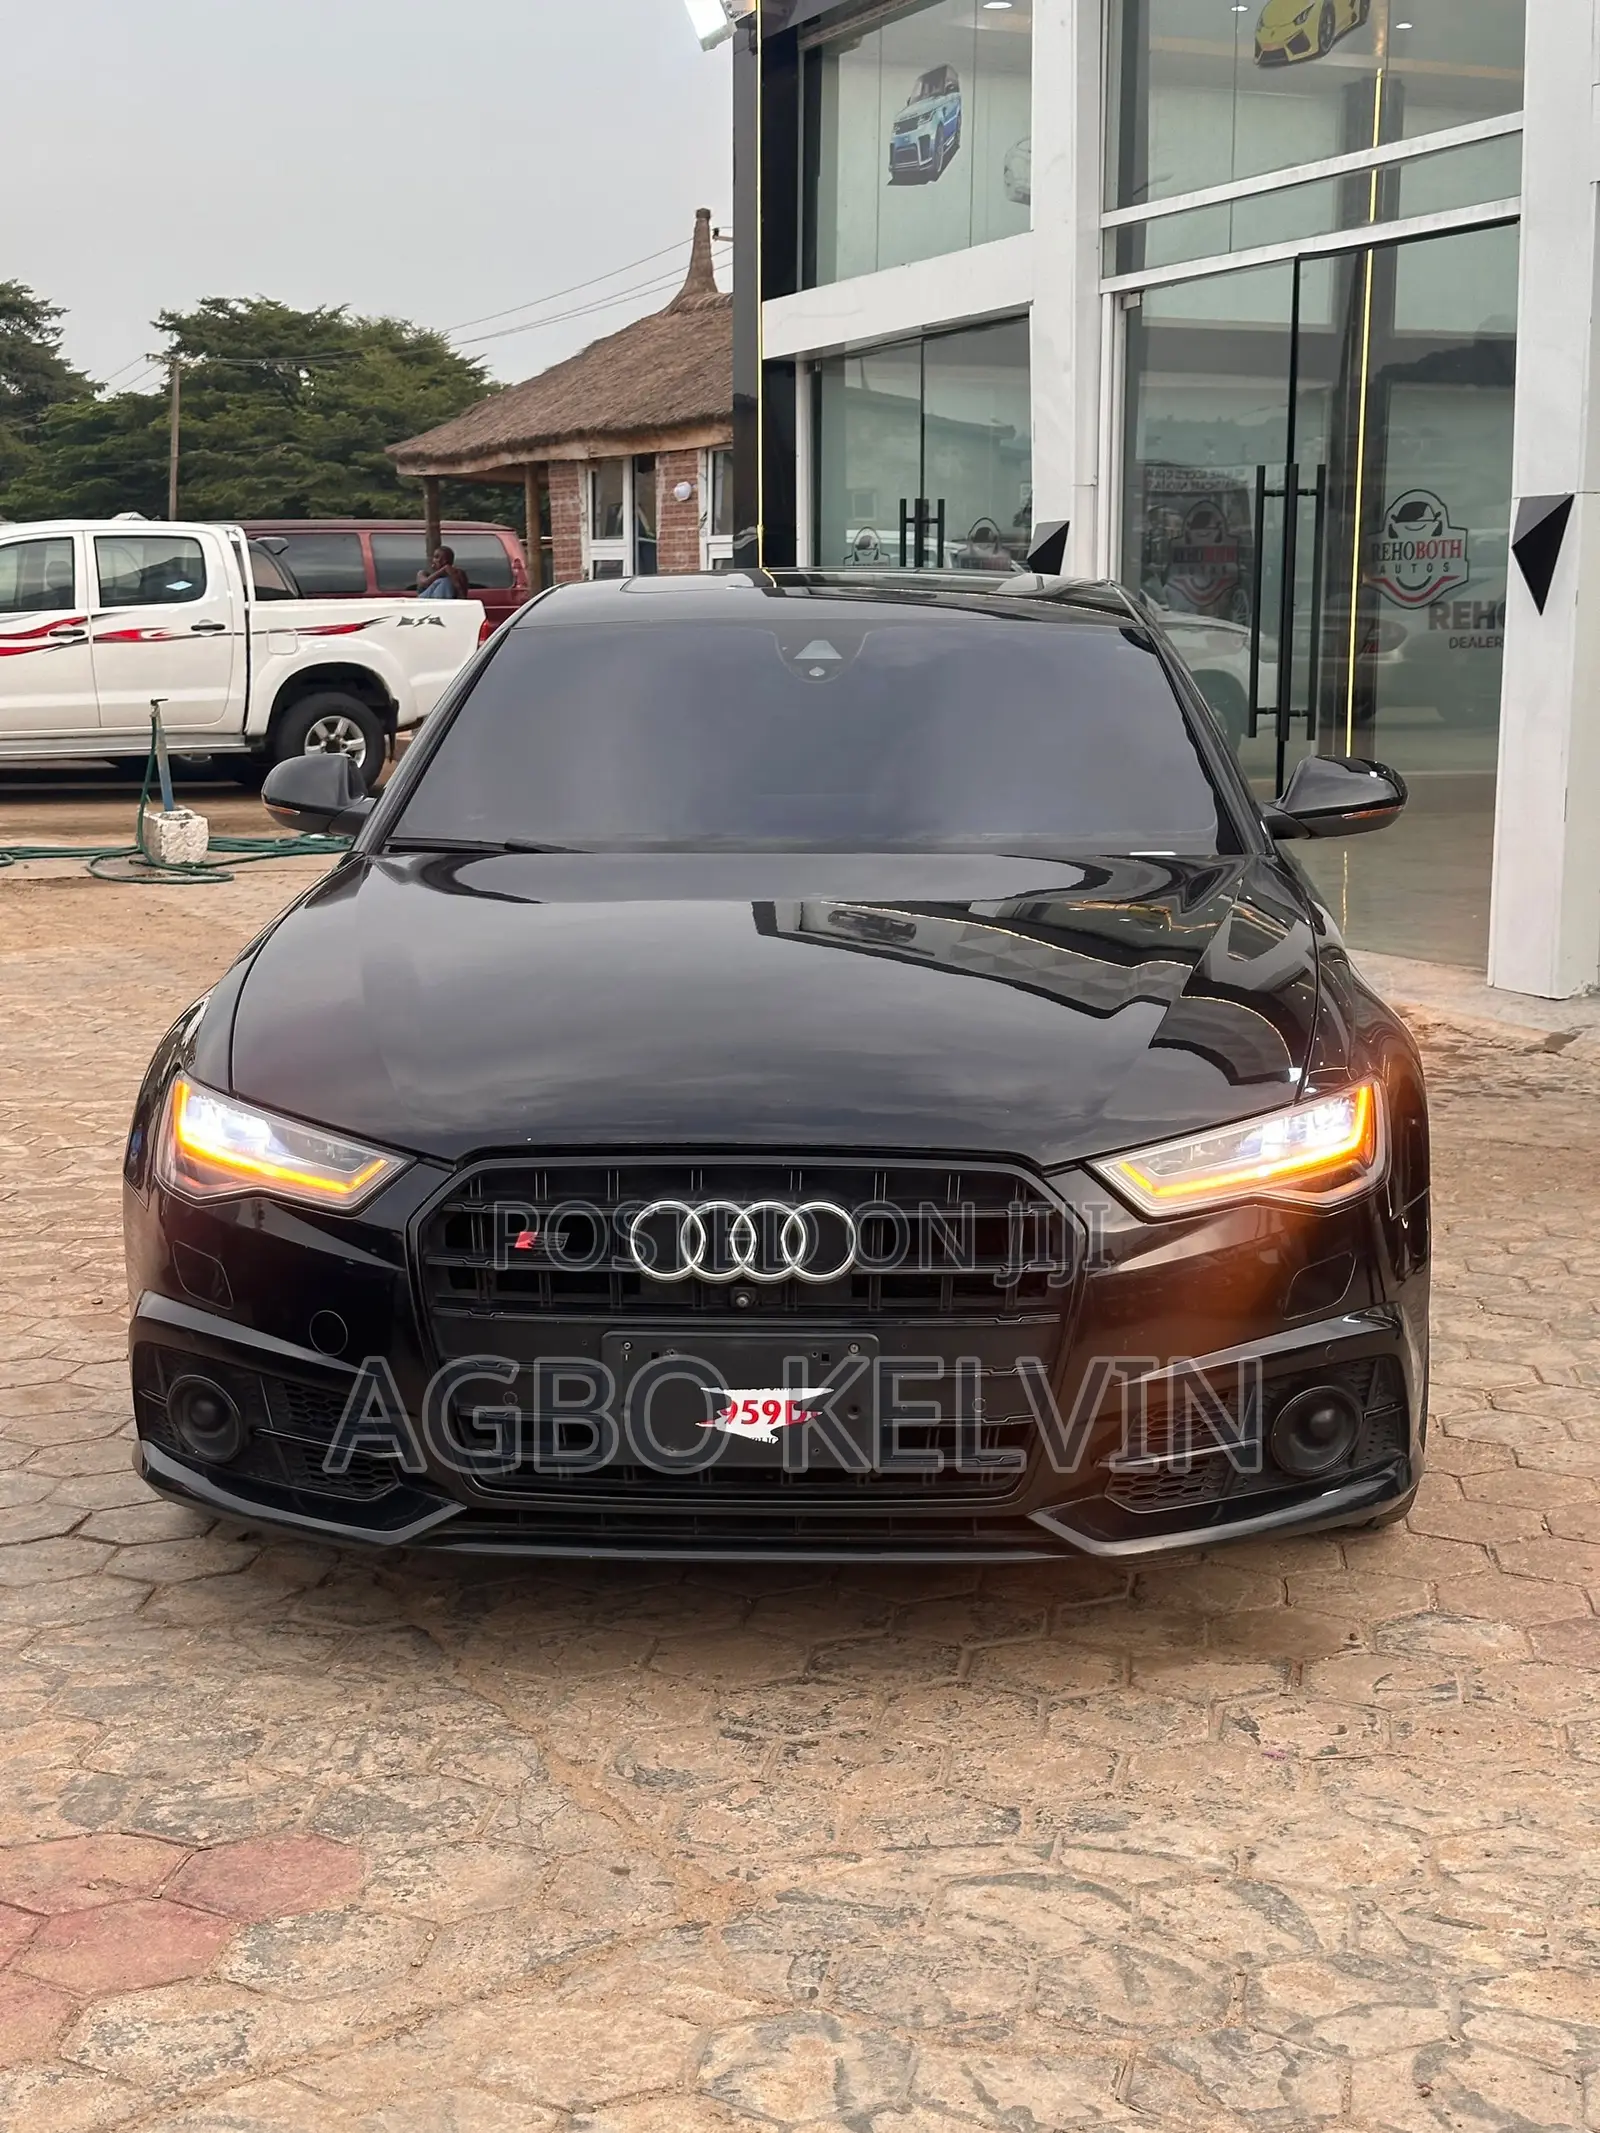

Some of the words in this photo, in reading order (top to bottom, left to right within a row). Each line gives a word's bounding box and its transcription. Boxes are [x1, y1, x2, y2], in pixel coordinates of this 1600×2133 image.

[1371, 539, 1462, 561] REHOBOTH
[1380, 562, 1450, 575] AUTOS
[702, 1399, 818, 1426] 959D
